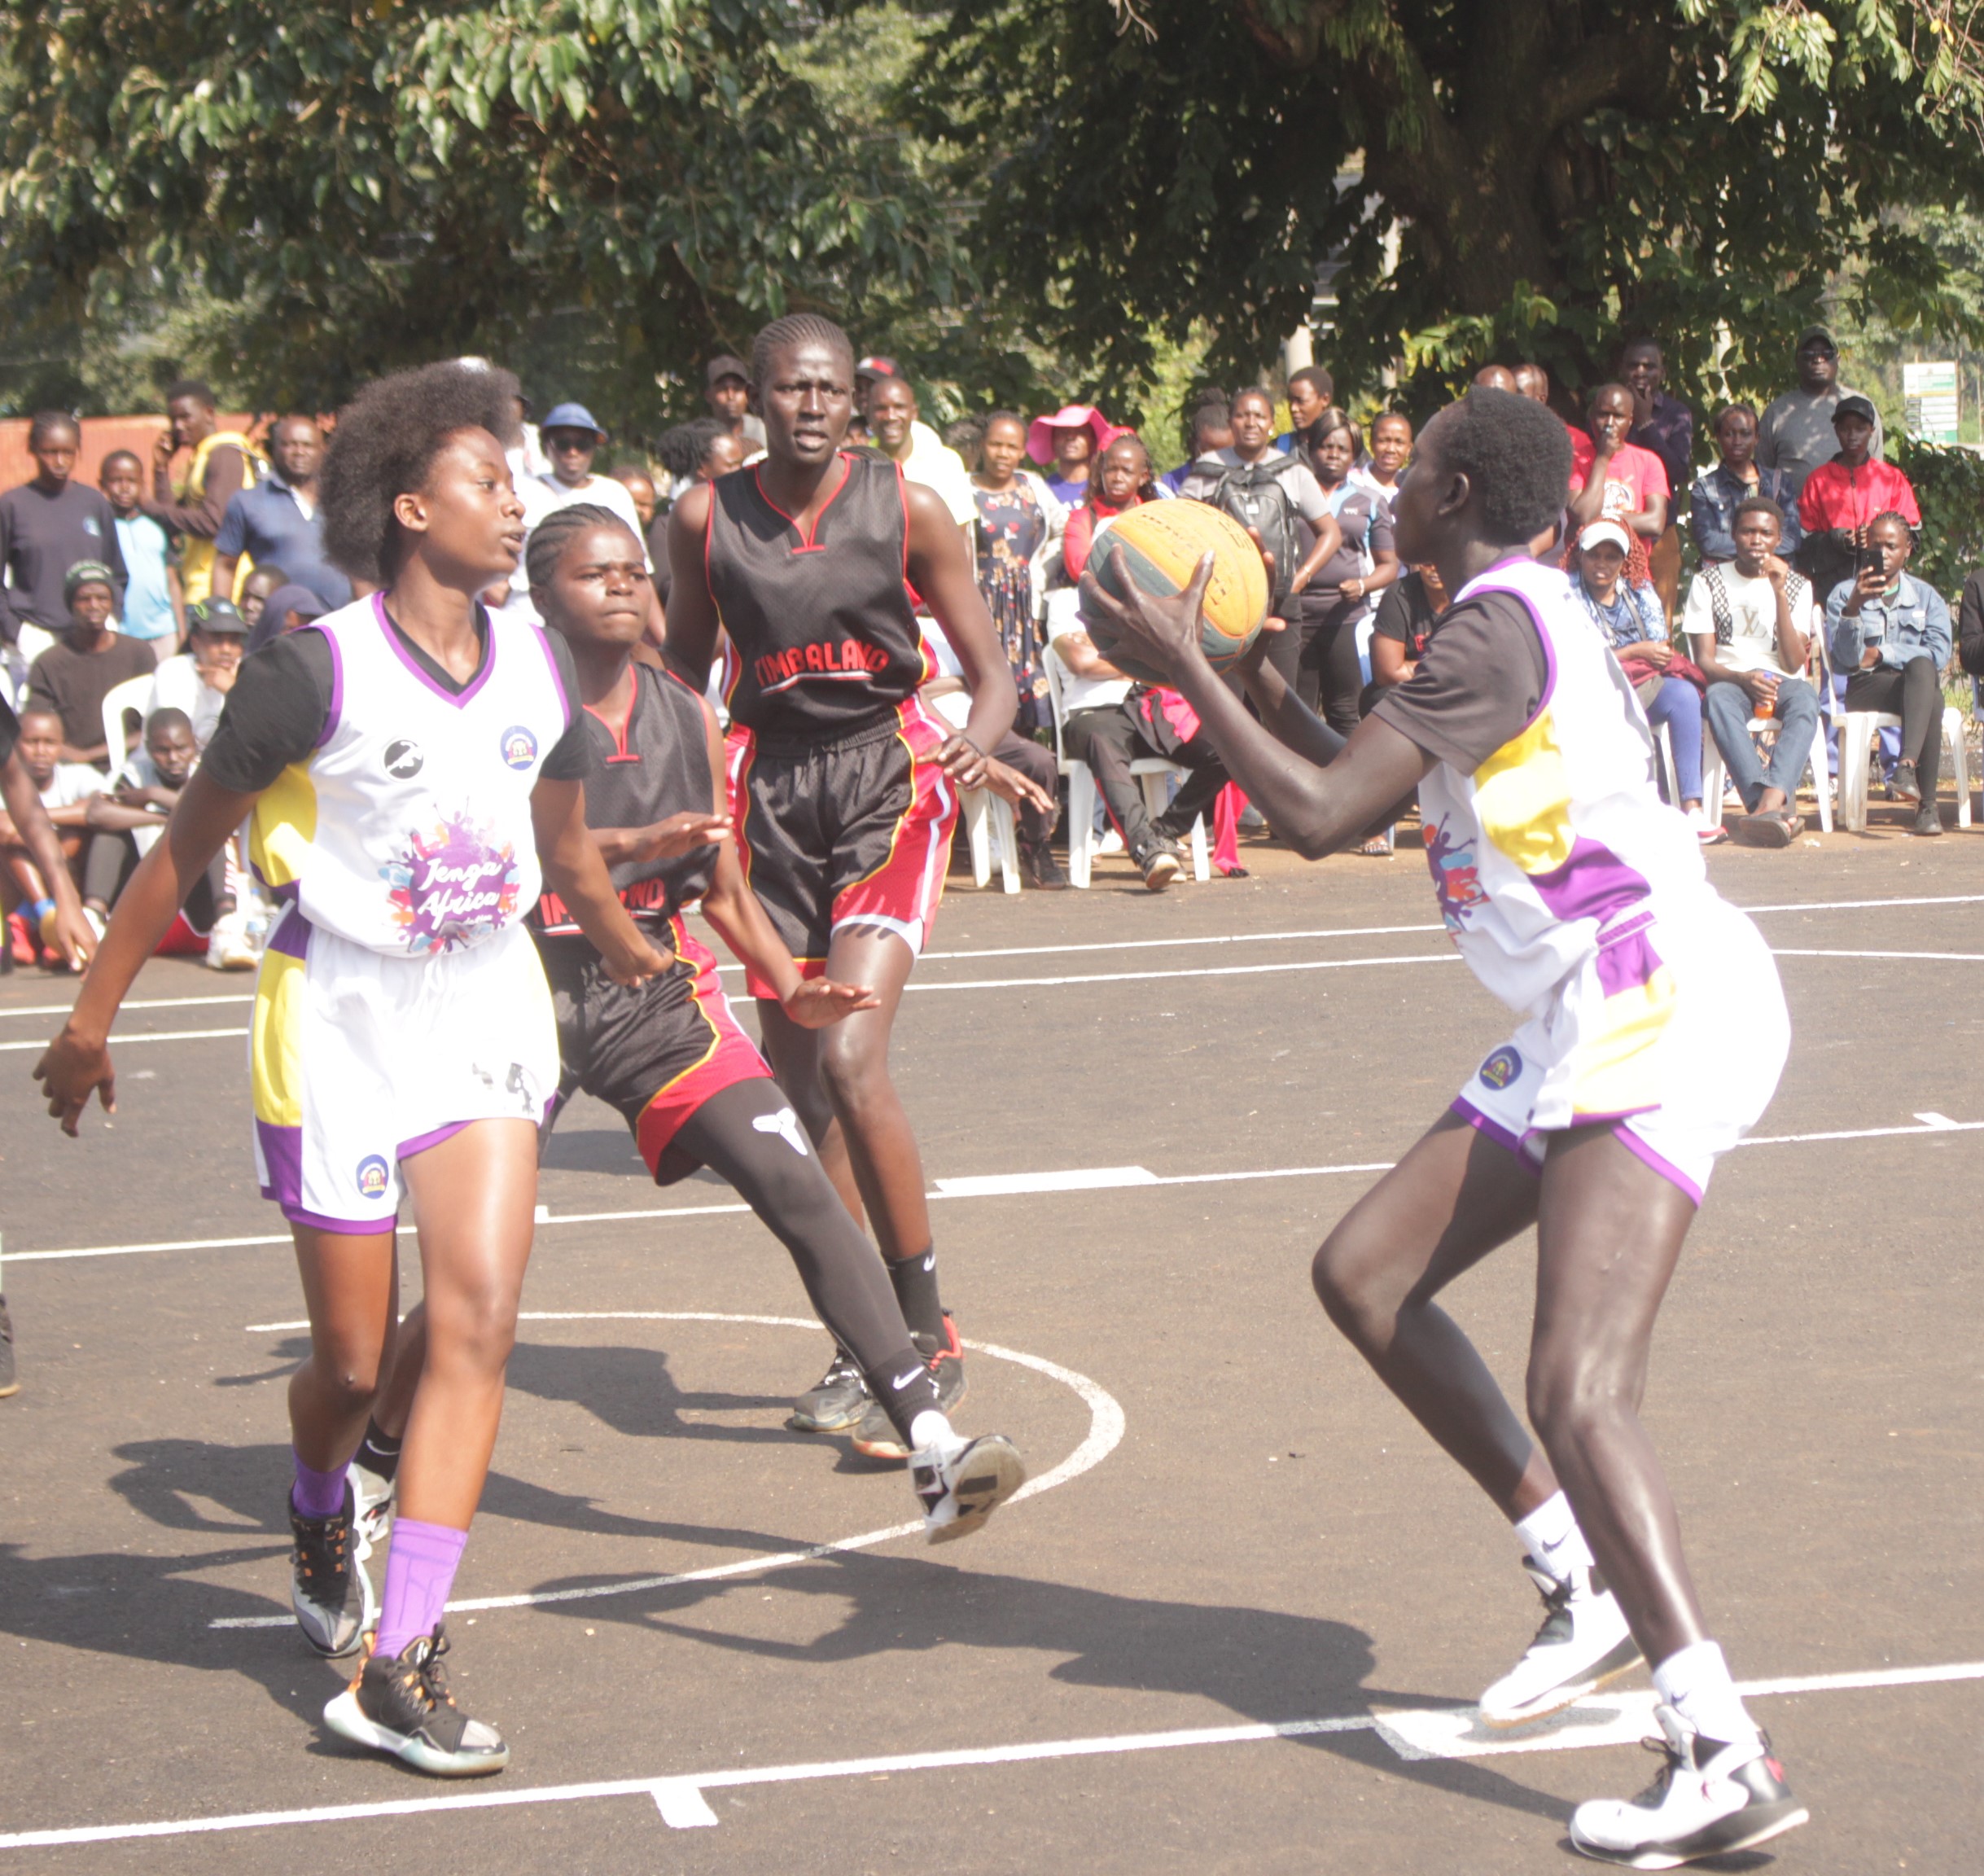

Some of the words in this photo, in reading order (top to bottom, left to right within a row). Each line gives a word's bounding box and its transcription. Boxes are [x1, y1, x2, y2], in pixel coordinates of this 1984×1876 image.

[755, 638, 889, 687] TIMBALAND
[418, 857, 502, 891] Jenga
[417, 888, 500, 930] Africa
